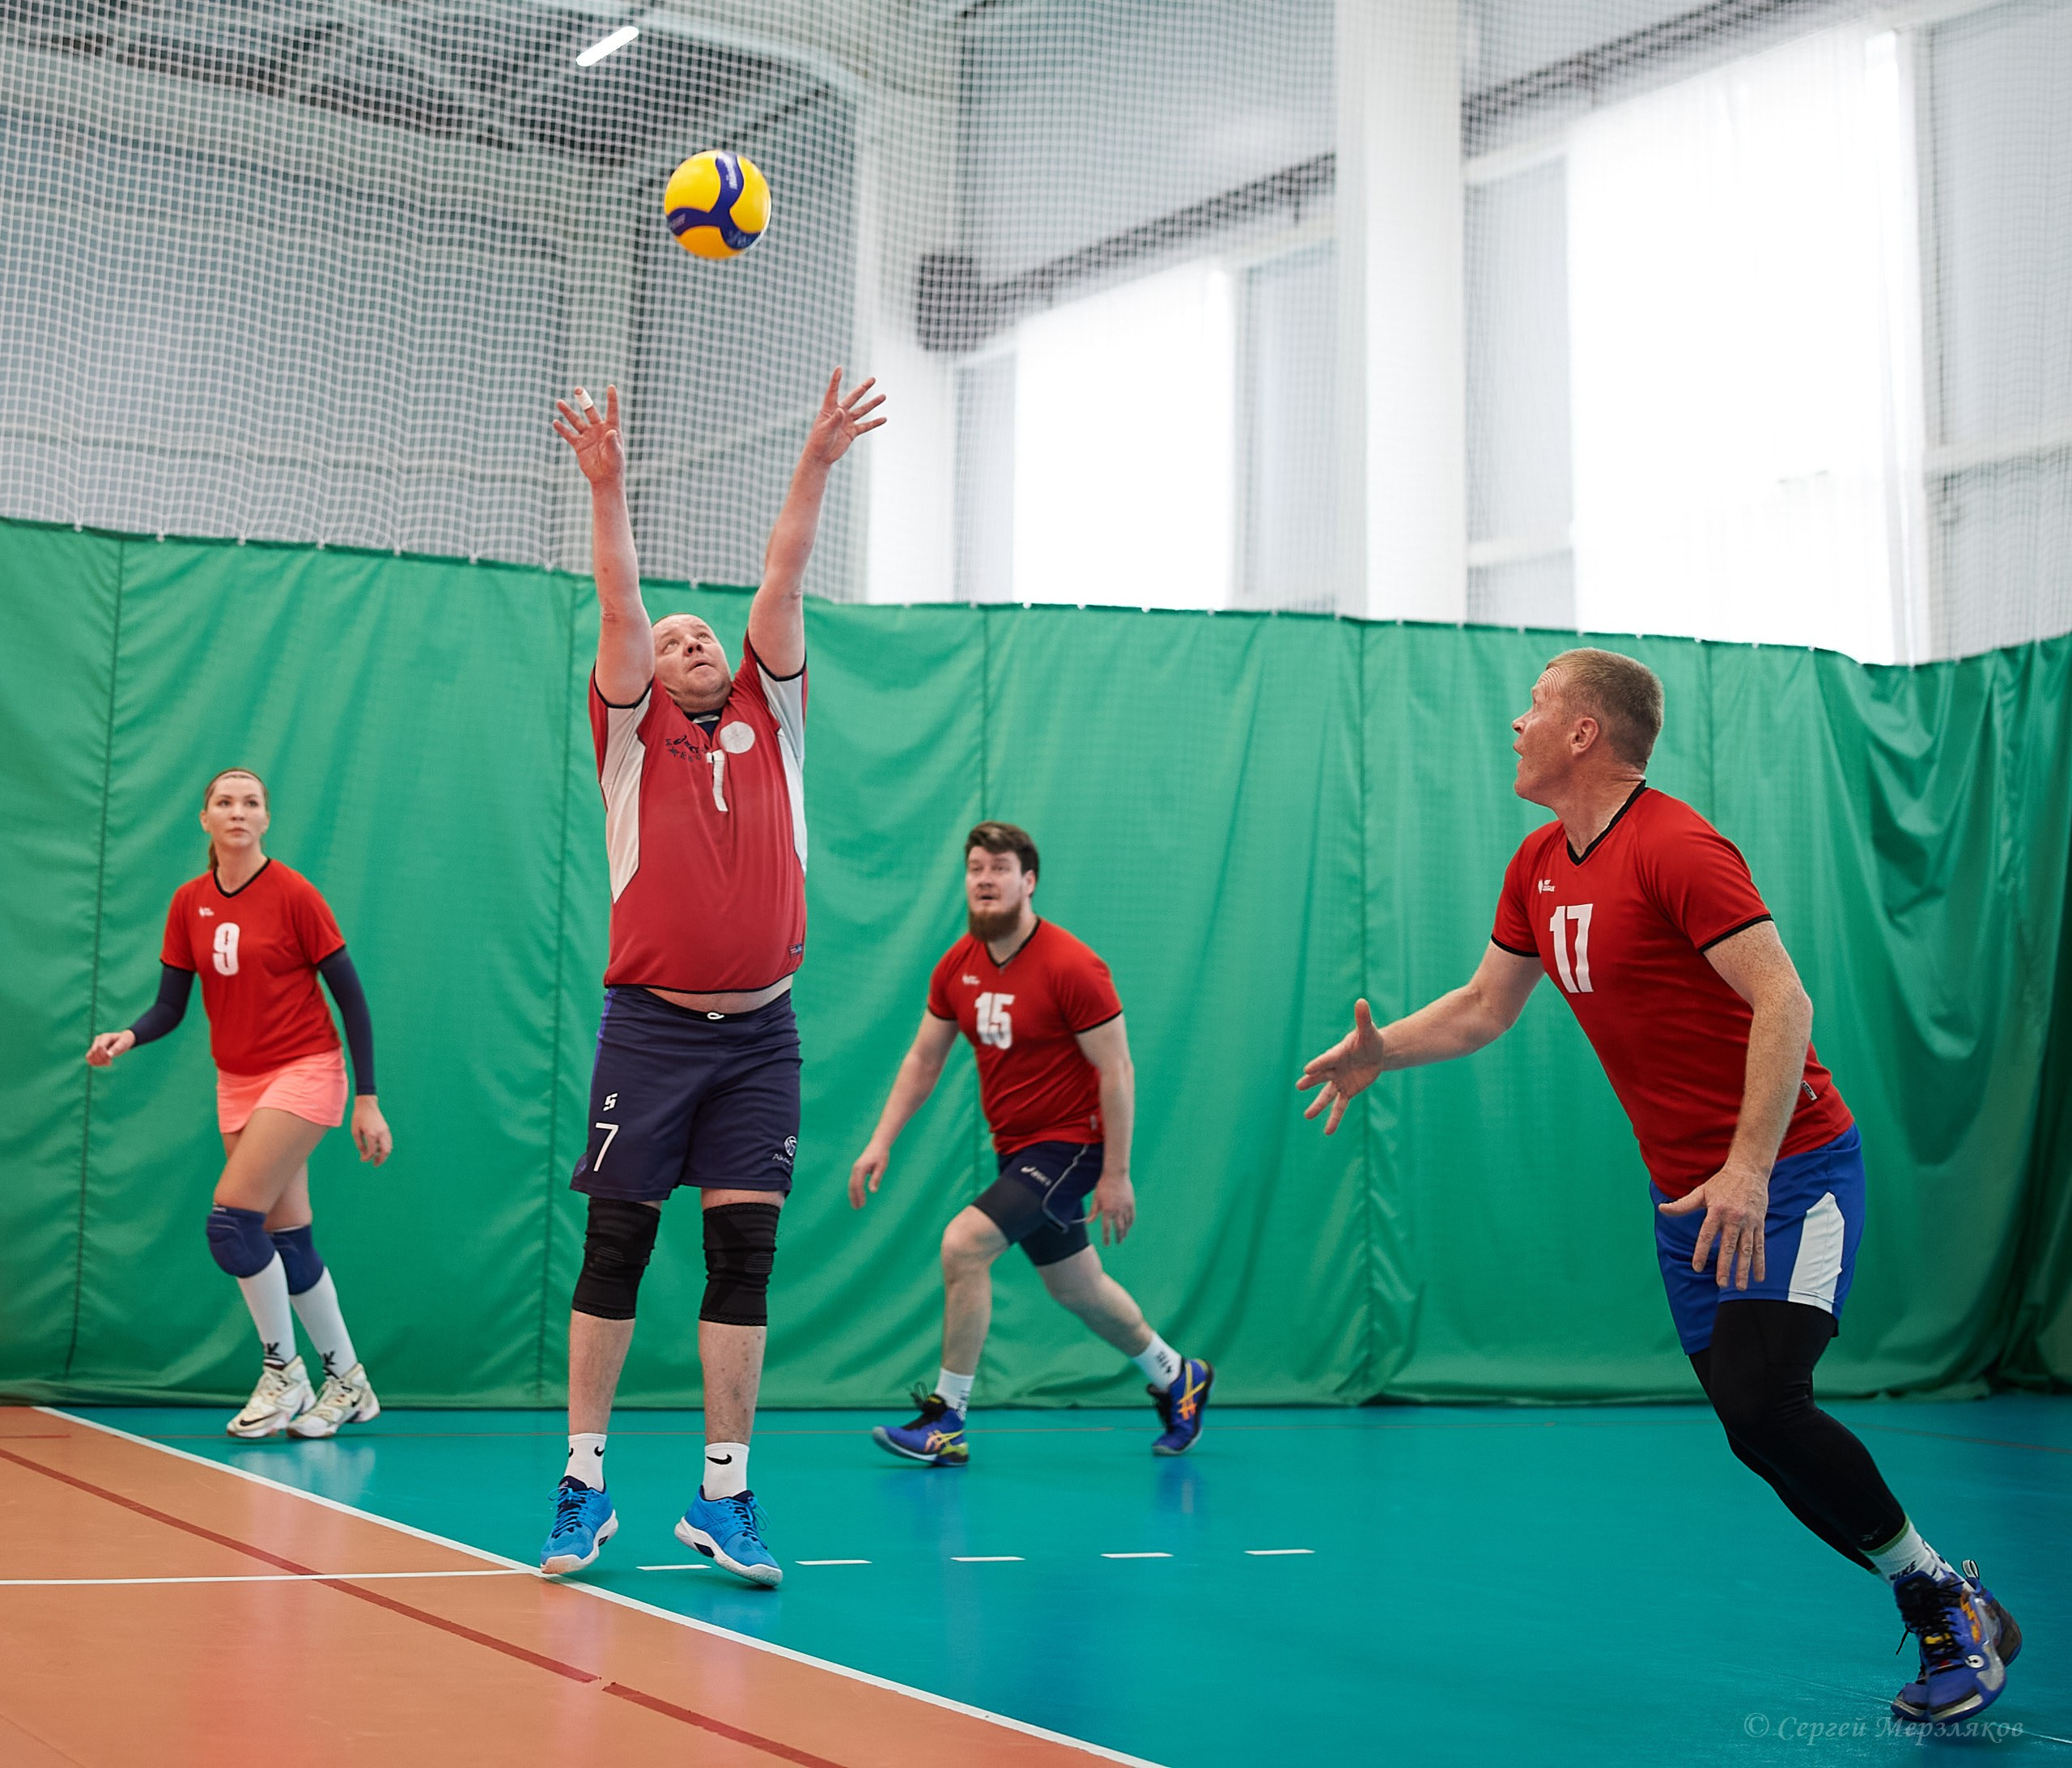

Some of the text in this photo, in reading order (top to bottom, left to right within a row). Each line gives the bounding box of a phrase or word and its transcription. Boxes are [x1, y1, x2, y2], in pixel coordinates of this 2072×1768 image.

[212, 922, 240, 976] 9
[1549, 903, 1594, 993] 17
[974, 992, 1016, 1050] 15
[593, 1122, 619, 1171] 7
